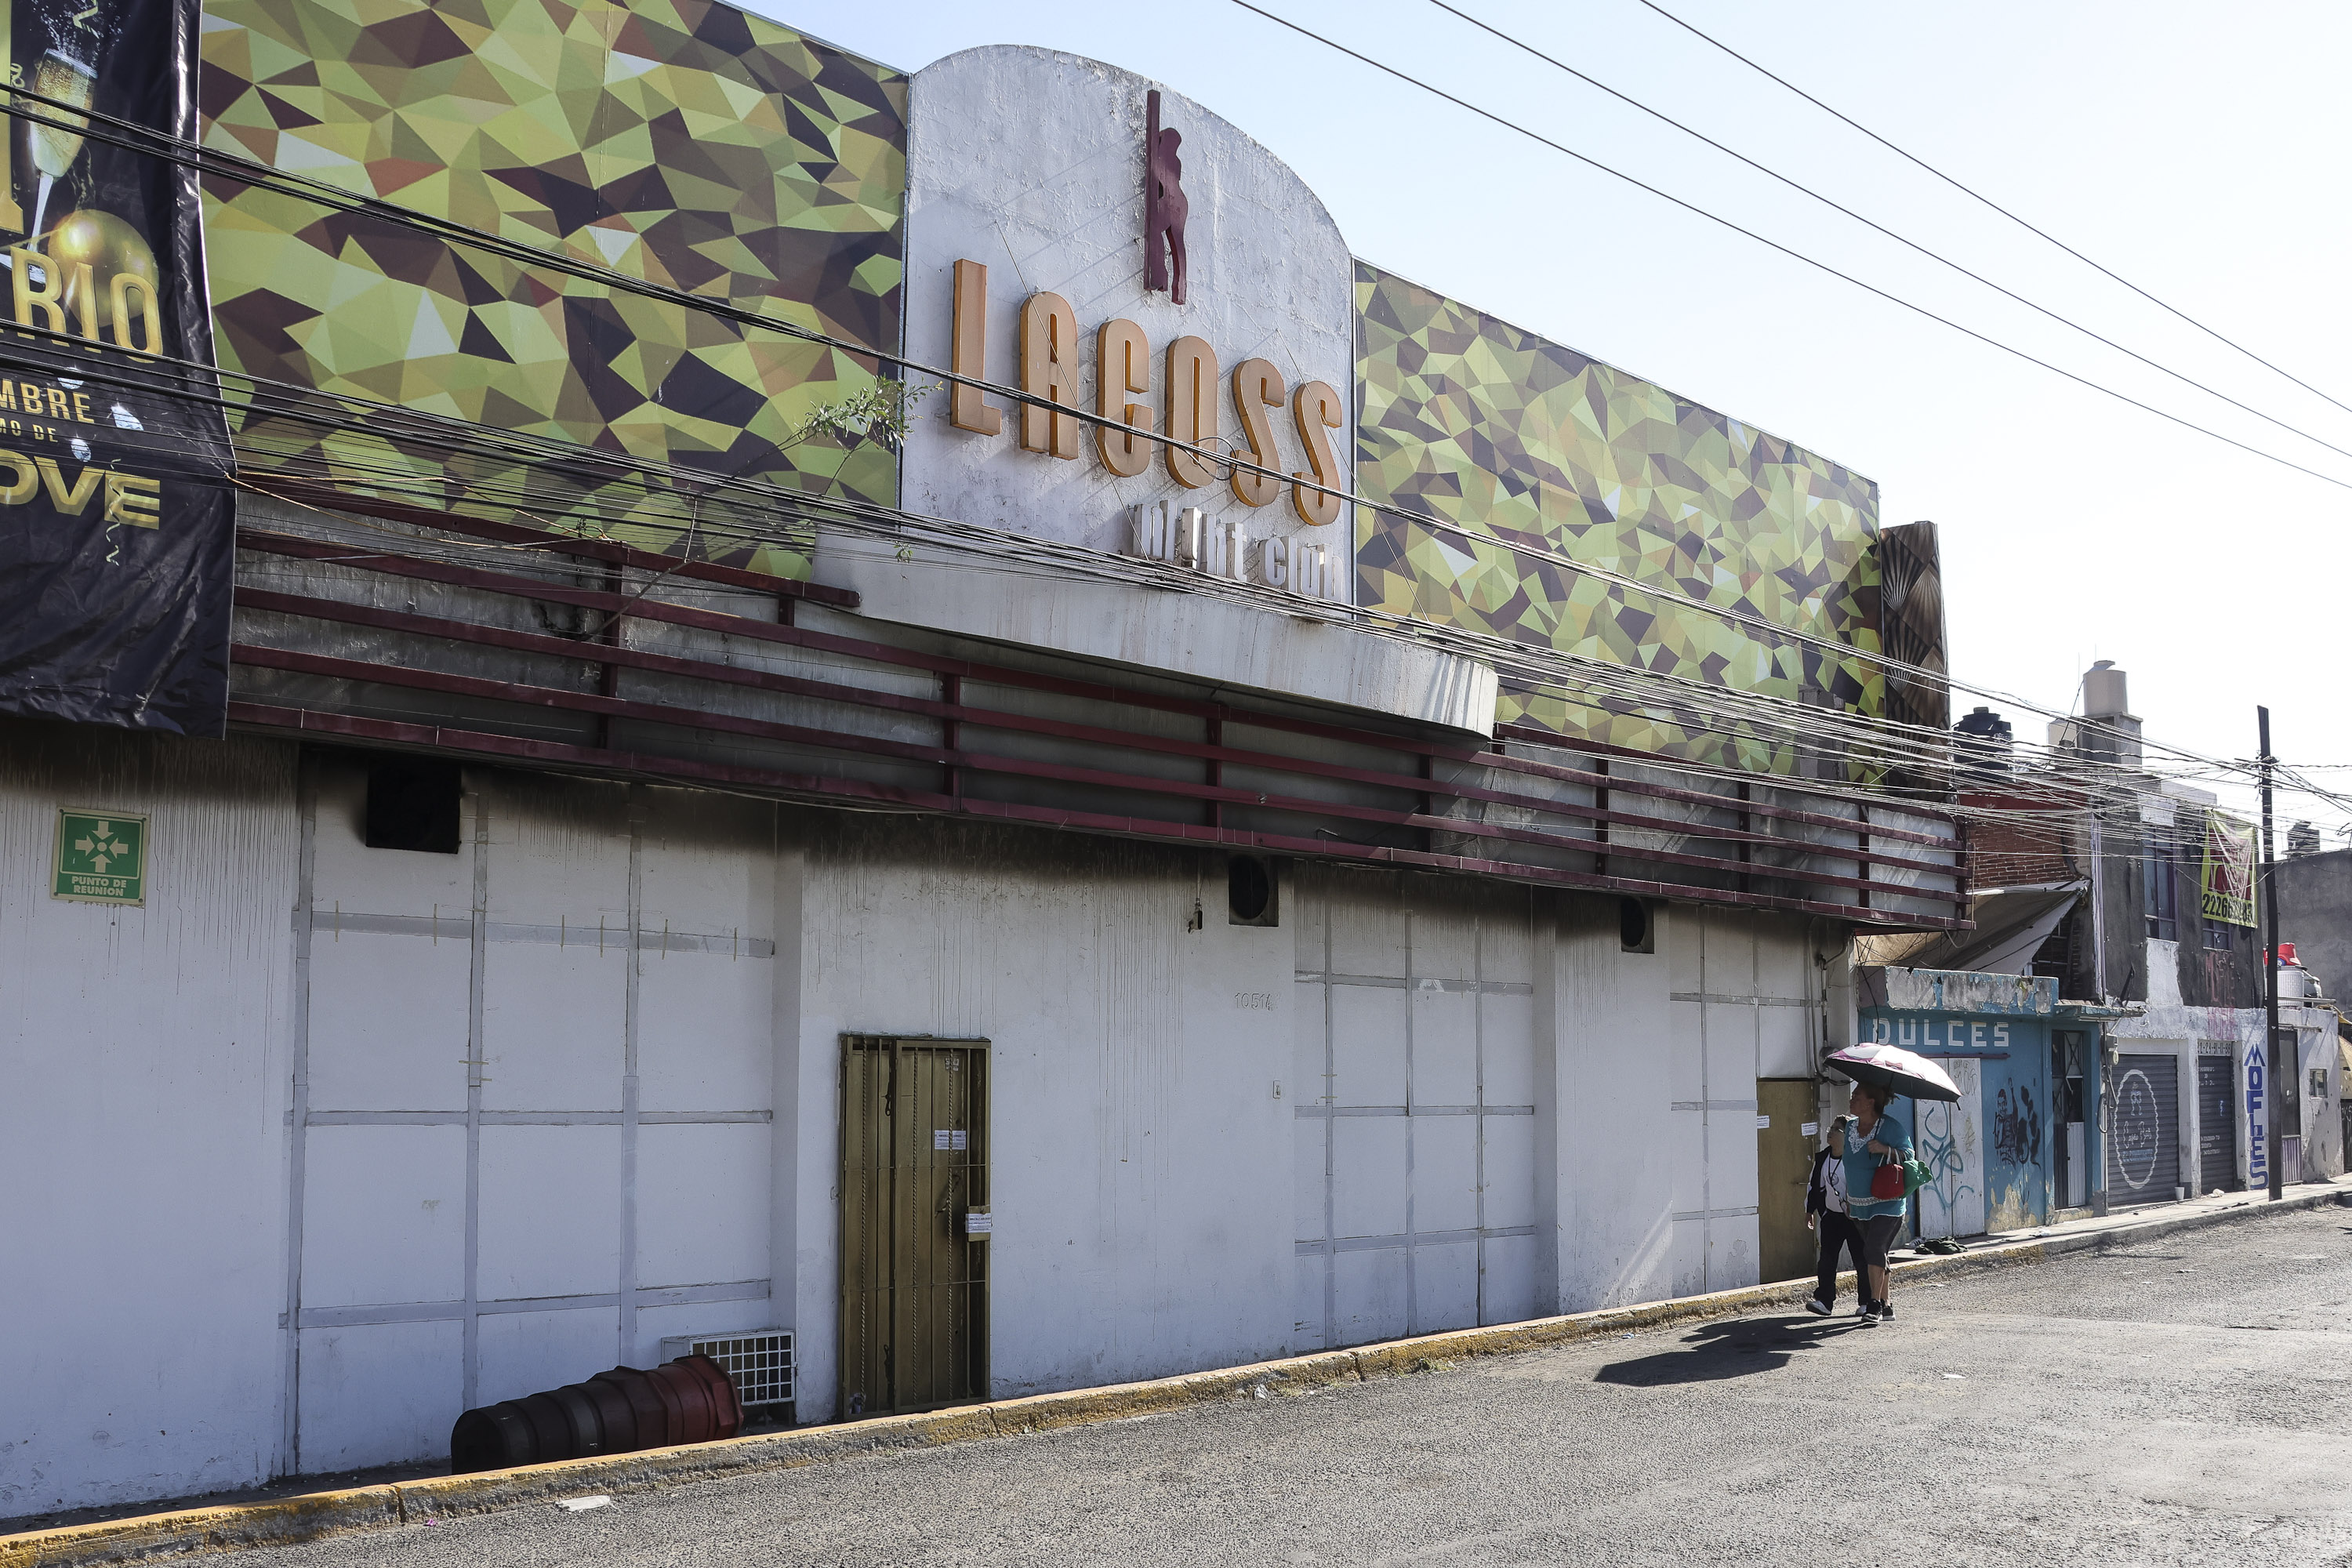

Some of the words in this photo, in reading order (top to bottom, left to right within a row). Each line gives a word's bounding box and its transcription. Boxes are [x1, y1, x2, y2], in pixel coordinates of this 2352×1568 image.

[0, 247, 163, 363] RIO
[33, 424, 58, 443] DE
[71, 876, 109, 887] PUNTO
[113, 879, 127, 888] DE
[73, 885, 124, 897] REUNION
[1872, 1018, 2009, 1047] DULCES
